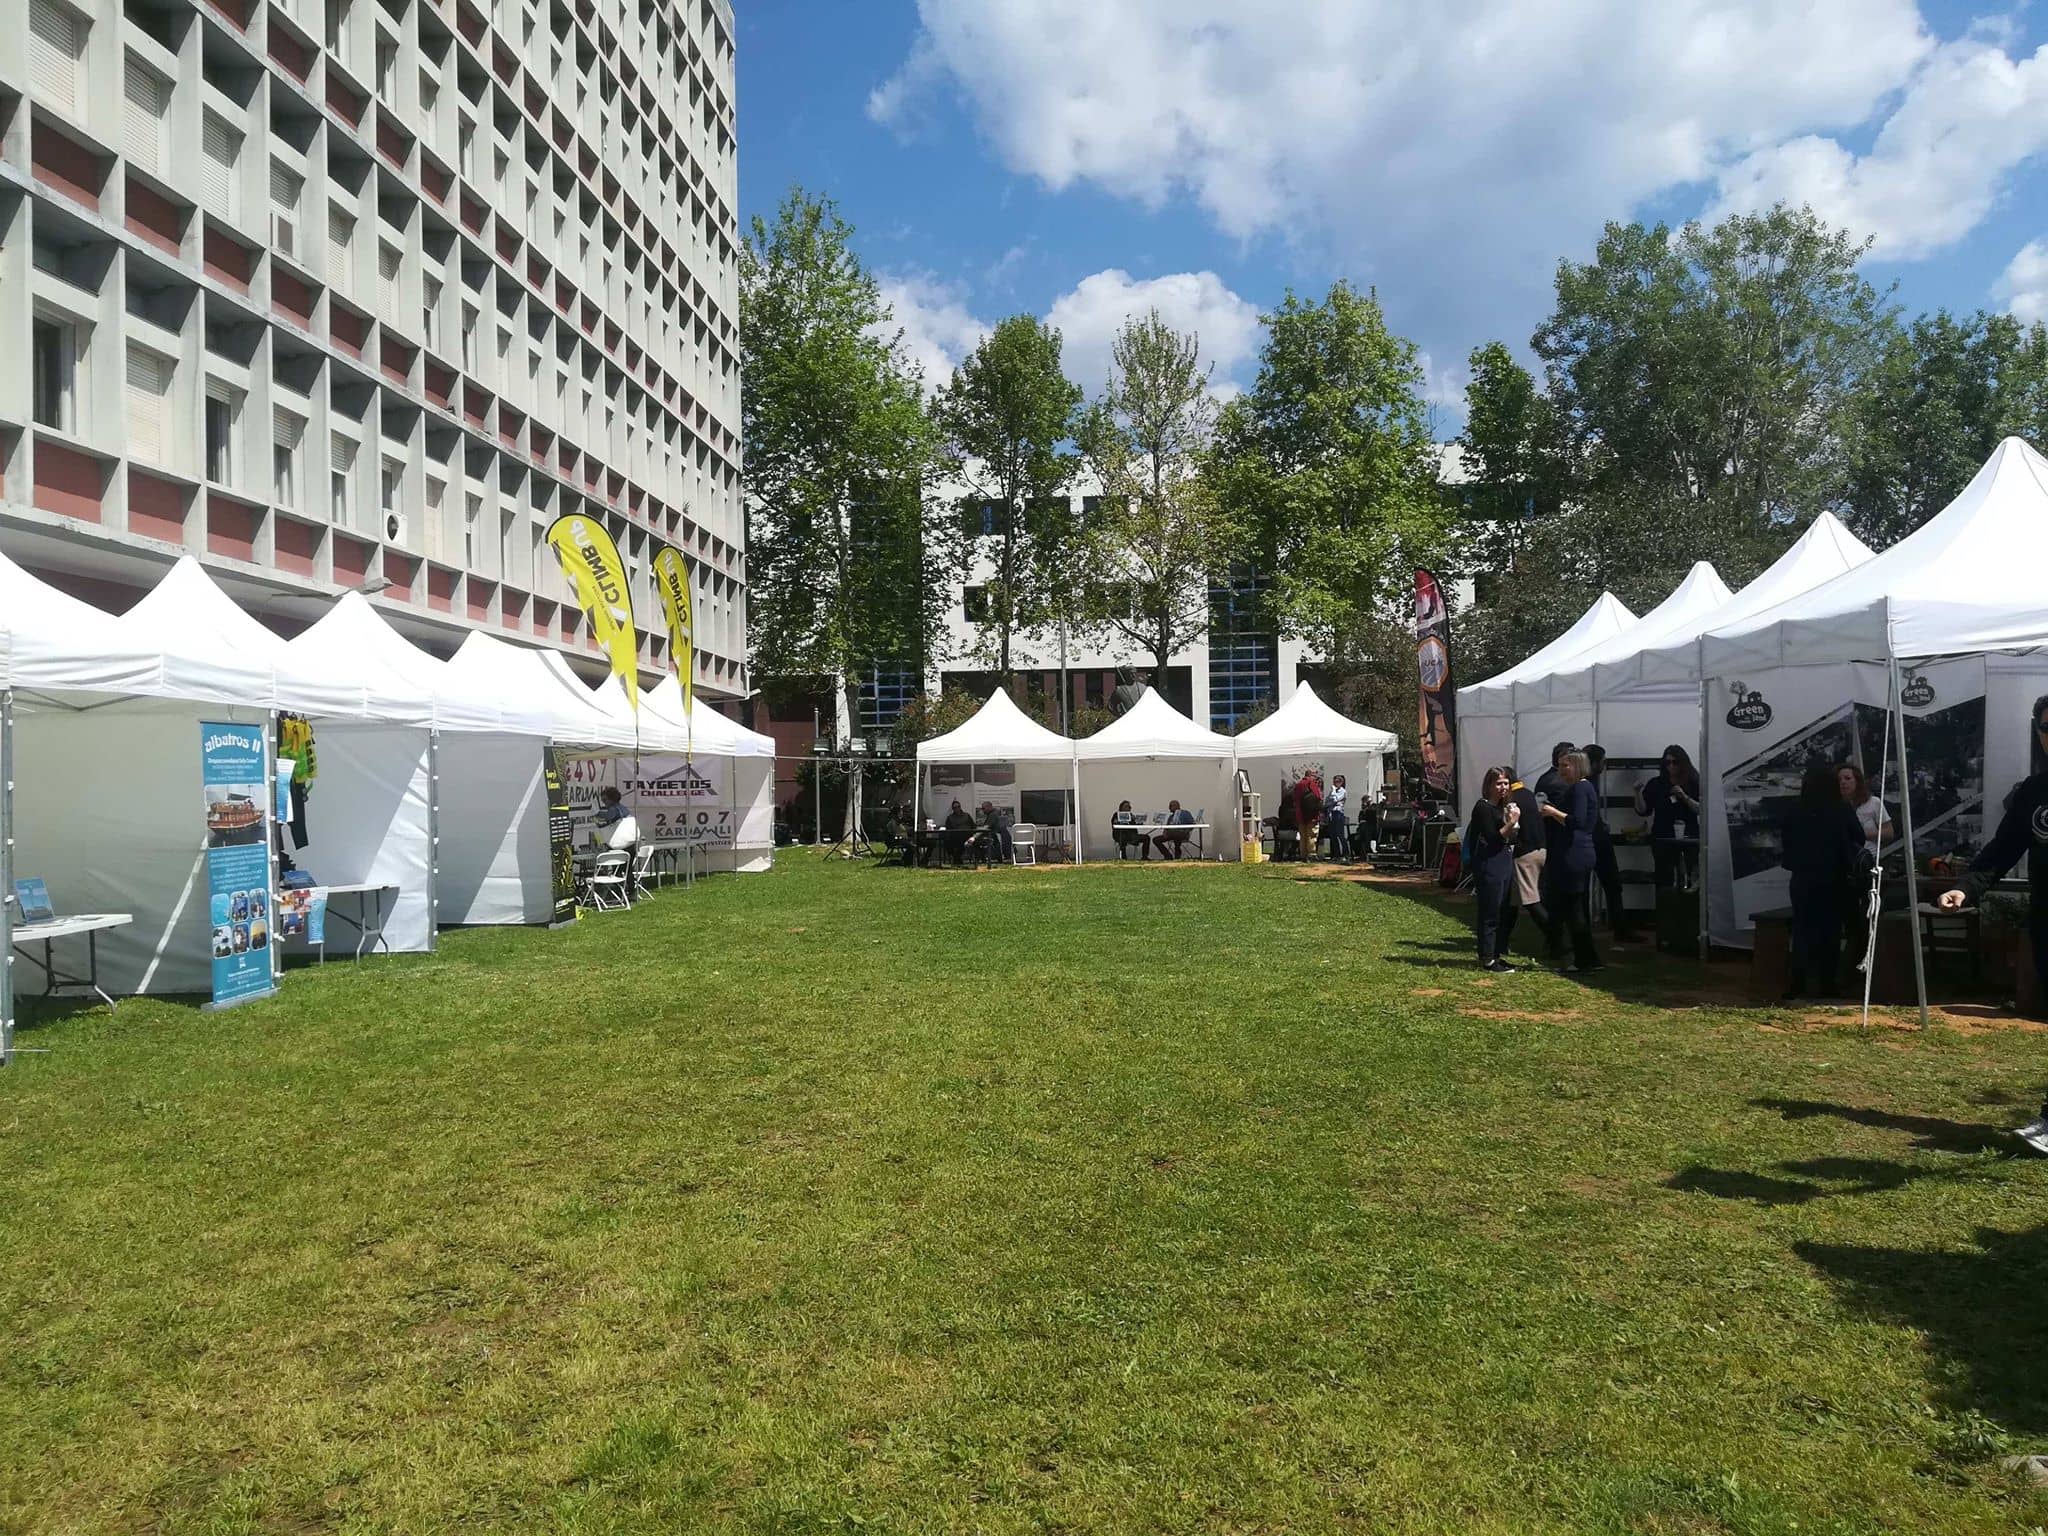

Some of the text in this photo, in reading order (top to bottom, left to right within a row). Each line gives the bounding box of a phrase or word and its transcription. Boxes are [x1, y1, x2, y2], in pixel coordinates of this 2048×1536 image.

[1734, 705, 1764, 717] Green
[204, 732, 249, 753] albatros
[622, 780, 712, 790] TAYGETOS
